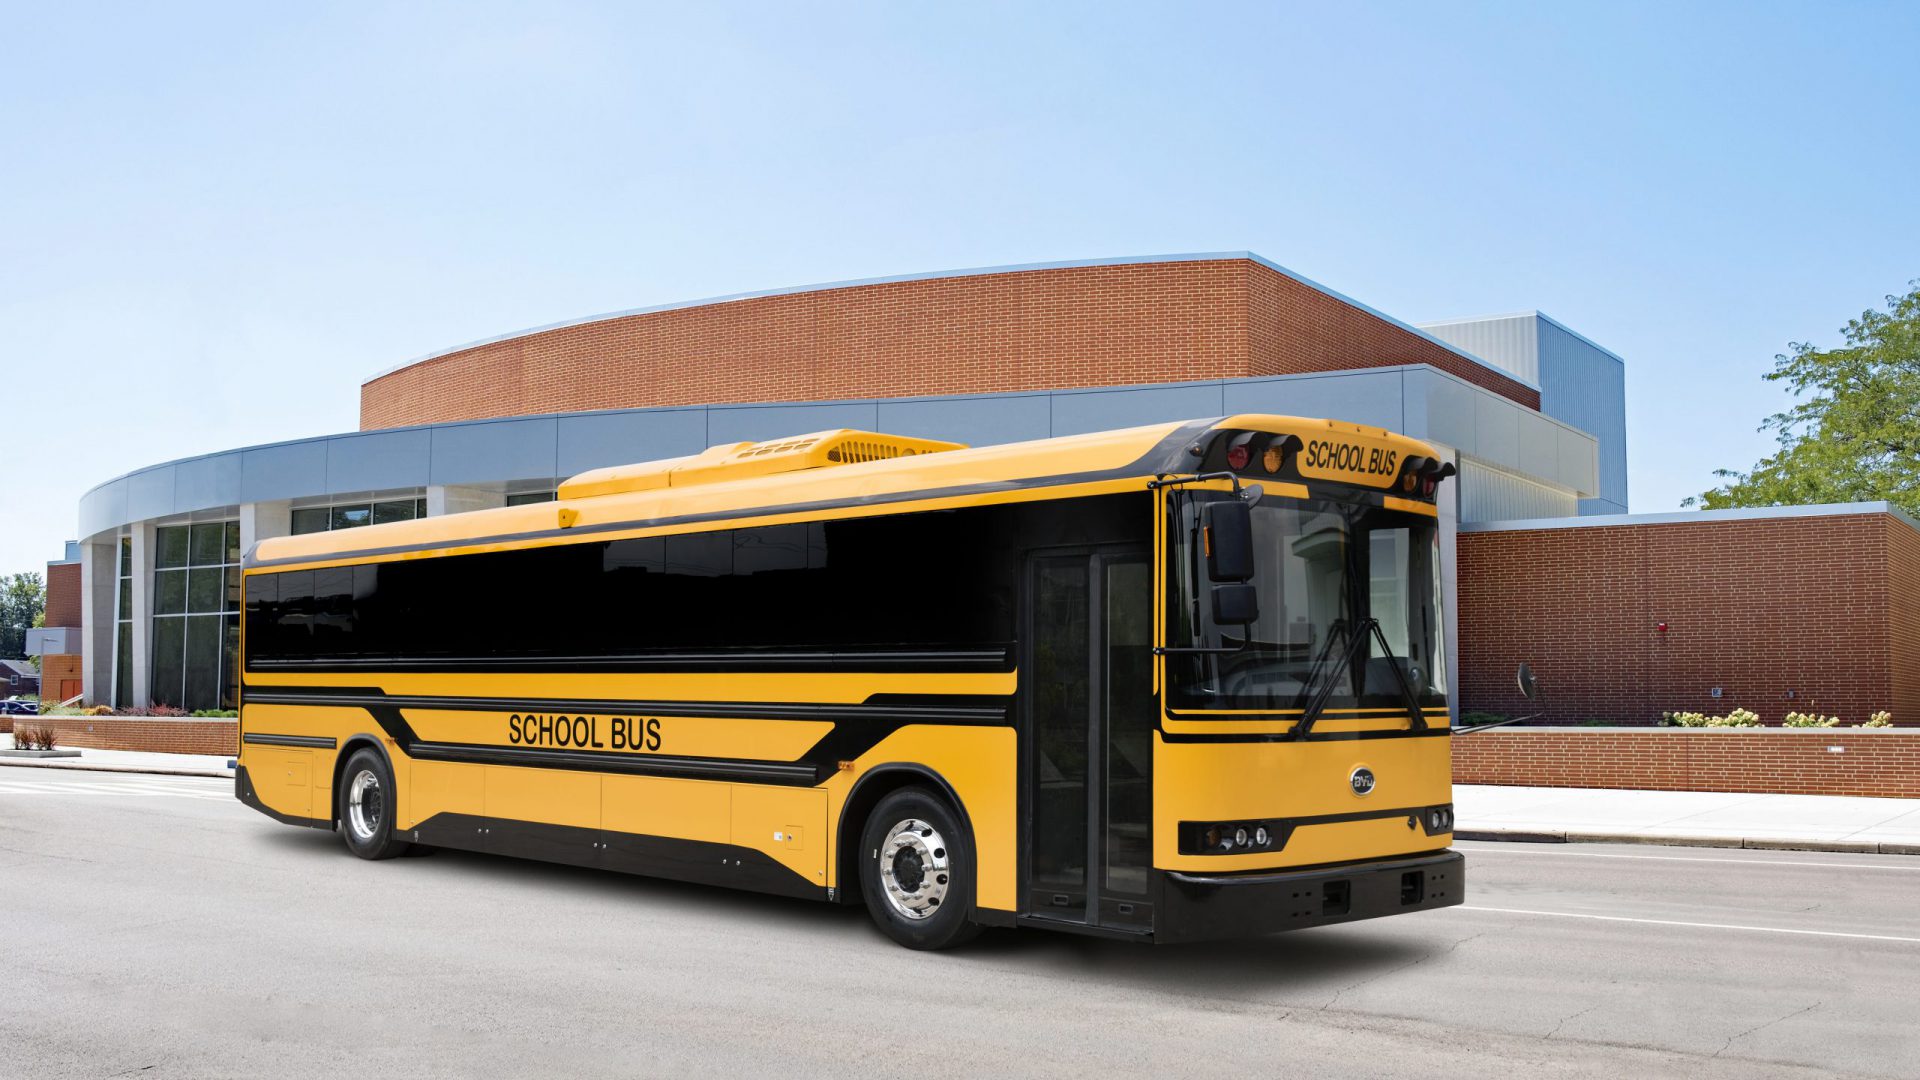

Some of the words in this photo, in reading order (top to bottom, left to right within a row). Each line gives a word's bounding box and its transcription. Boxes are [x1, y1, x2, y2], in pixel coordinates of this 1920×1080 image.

[1306, 440, 1365, 472] SCHOOL
[1368, 448, 1396, 476] BUS
[509, 714, 604, 748] SCHOOL
[611, 718, 661, 751] BUS
